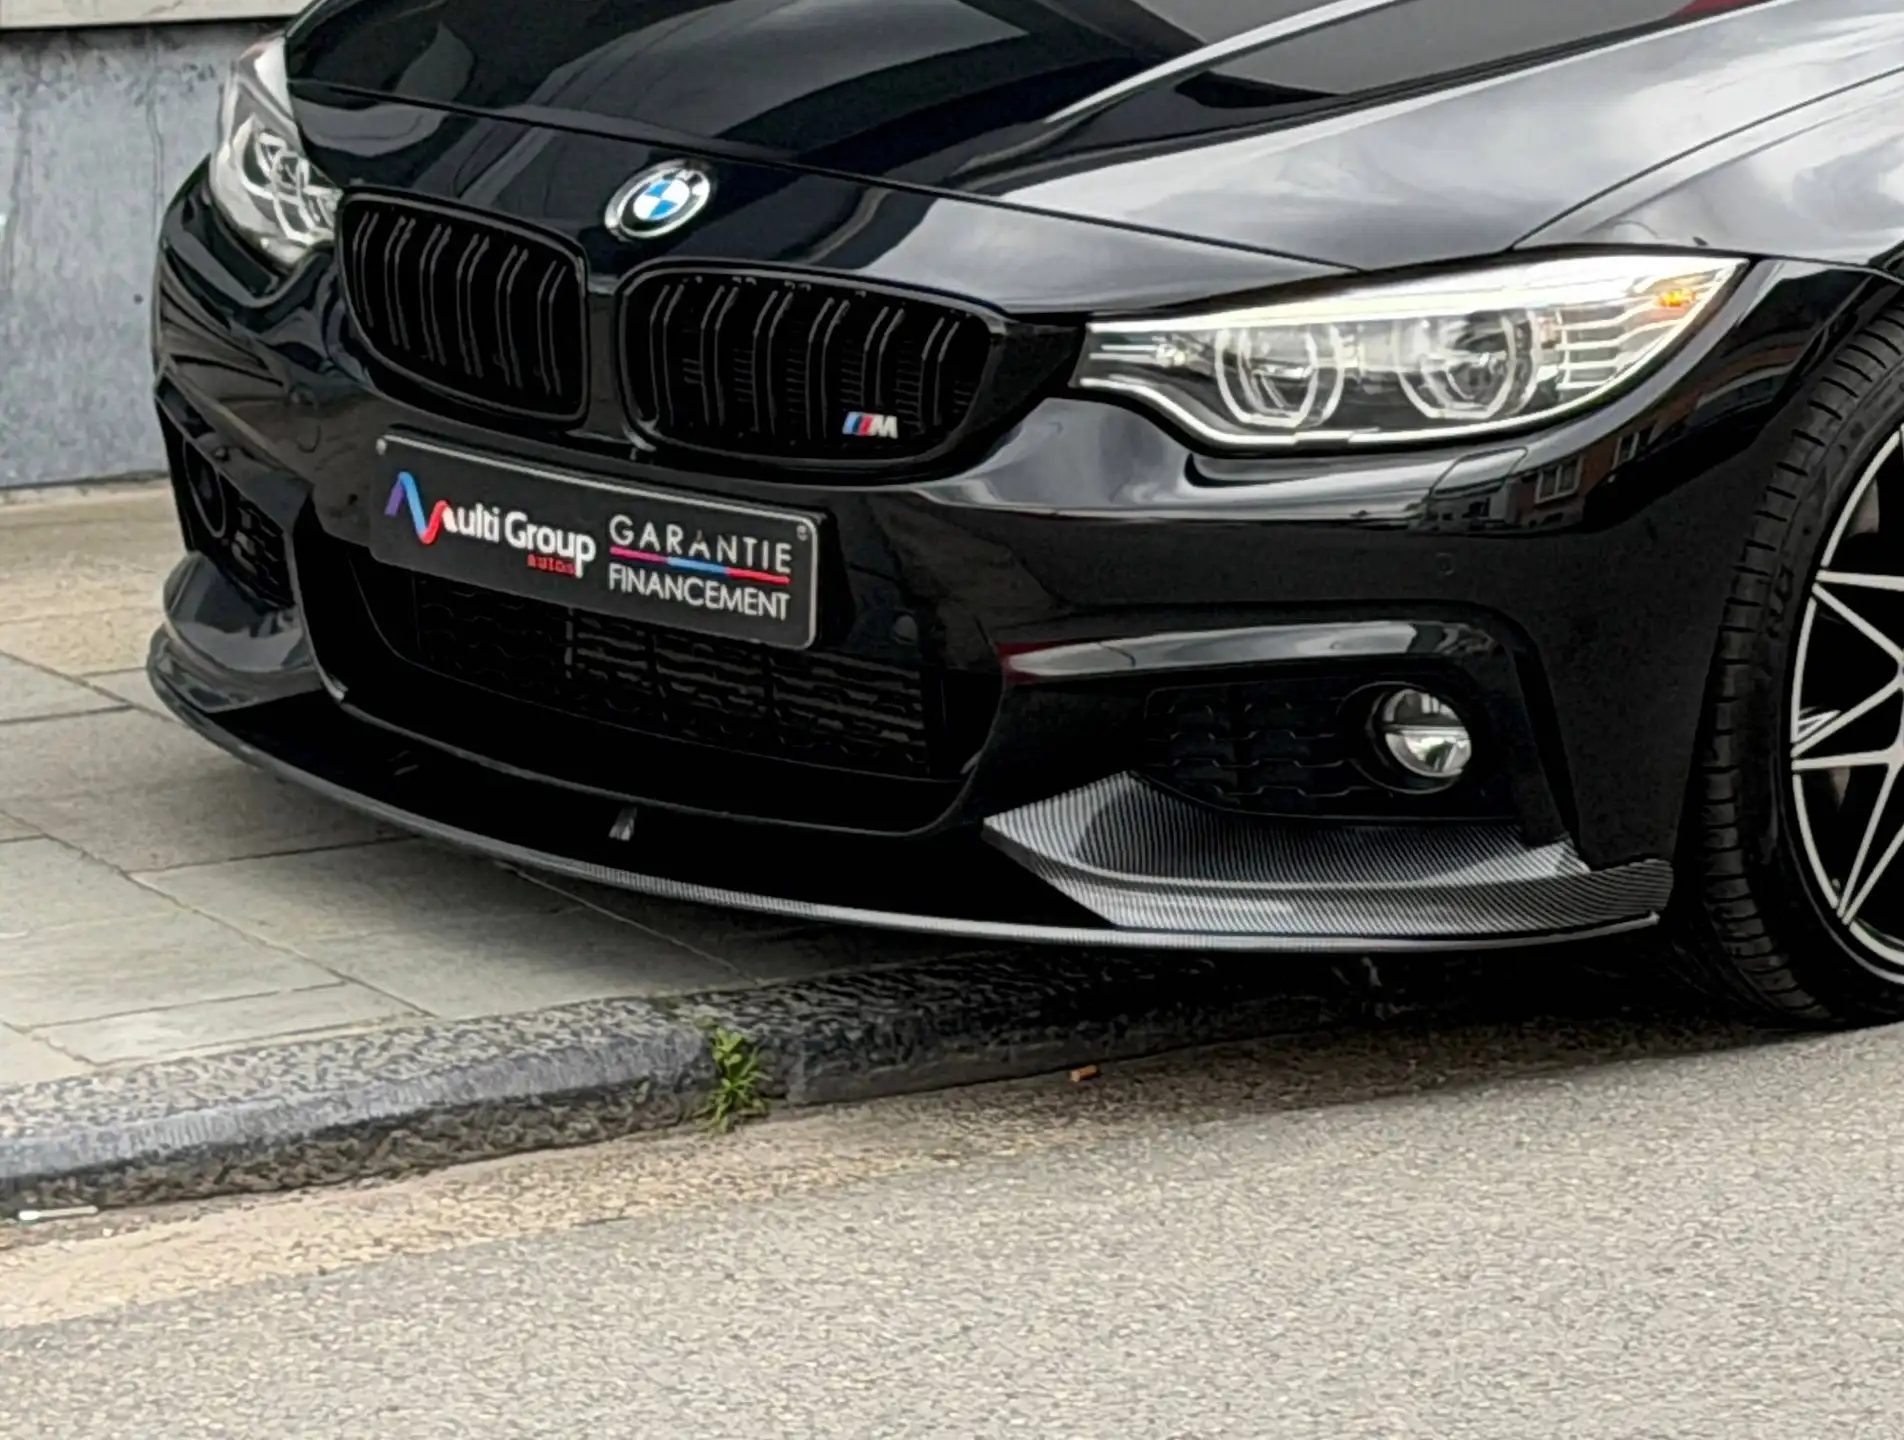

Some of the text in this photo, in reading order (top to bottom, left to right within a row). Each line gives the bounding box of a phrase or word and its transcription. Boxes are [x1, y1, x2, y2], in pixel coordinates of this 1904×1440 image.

[504, 511, 597, 579] Group
[609, 514, 792, 574] GARANTIE
[609, 562, 791, 621] FINANCEMENT
